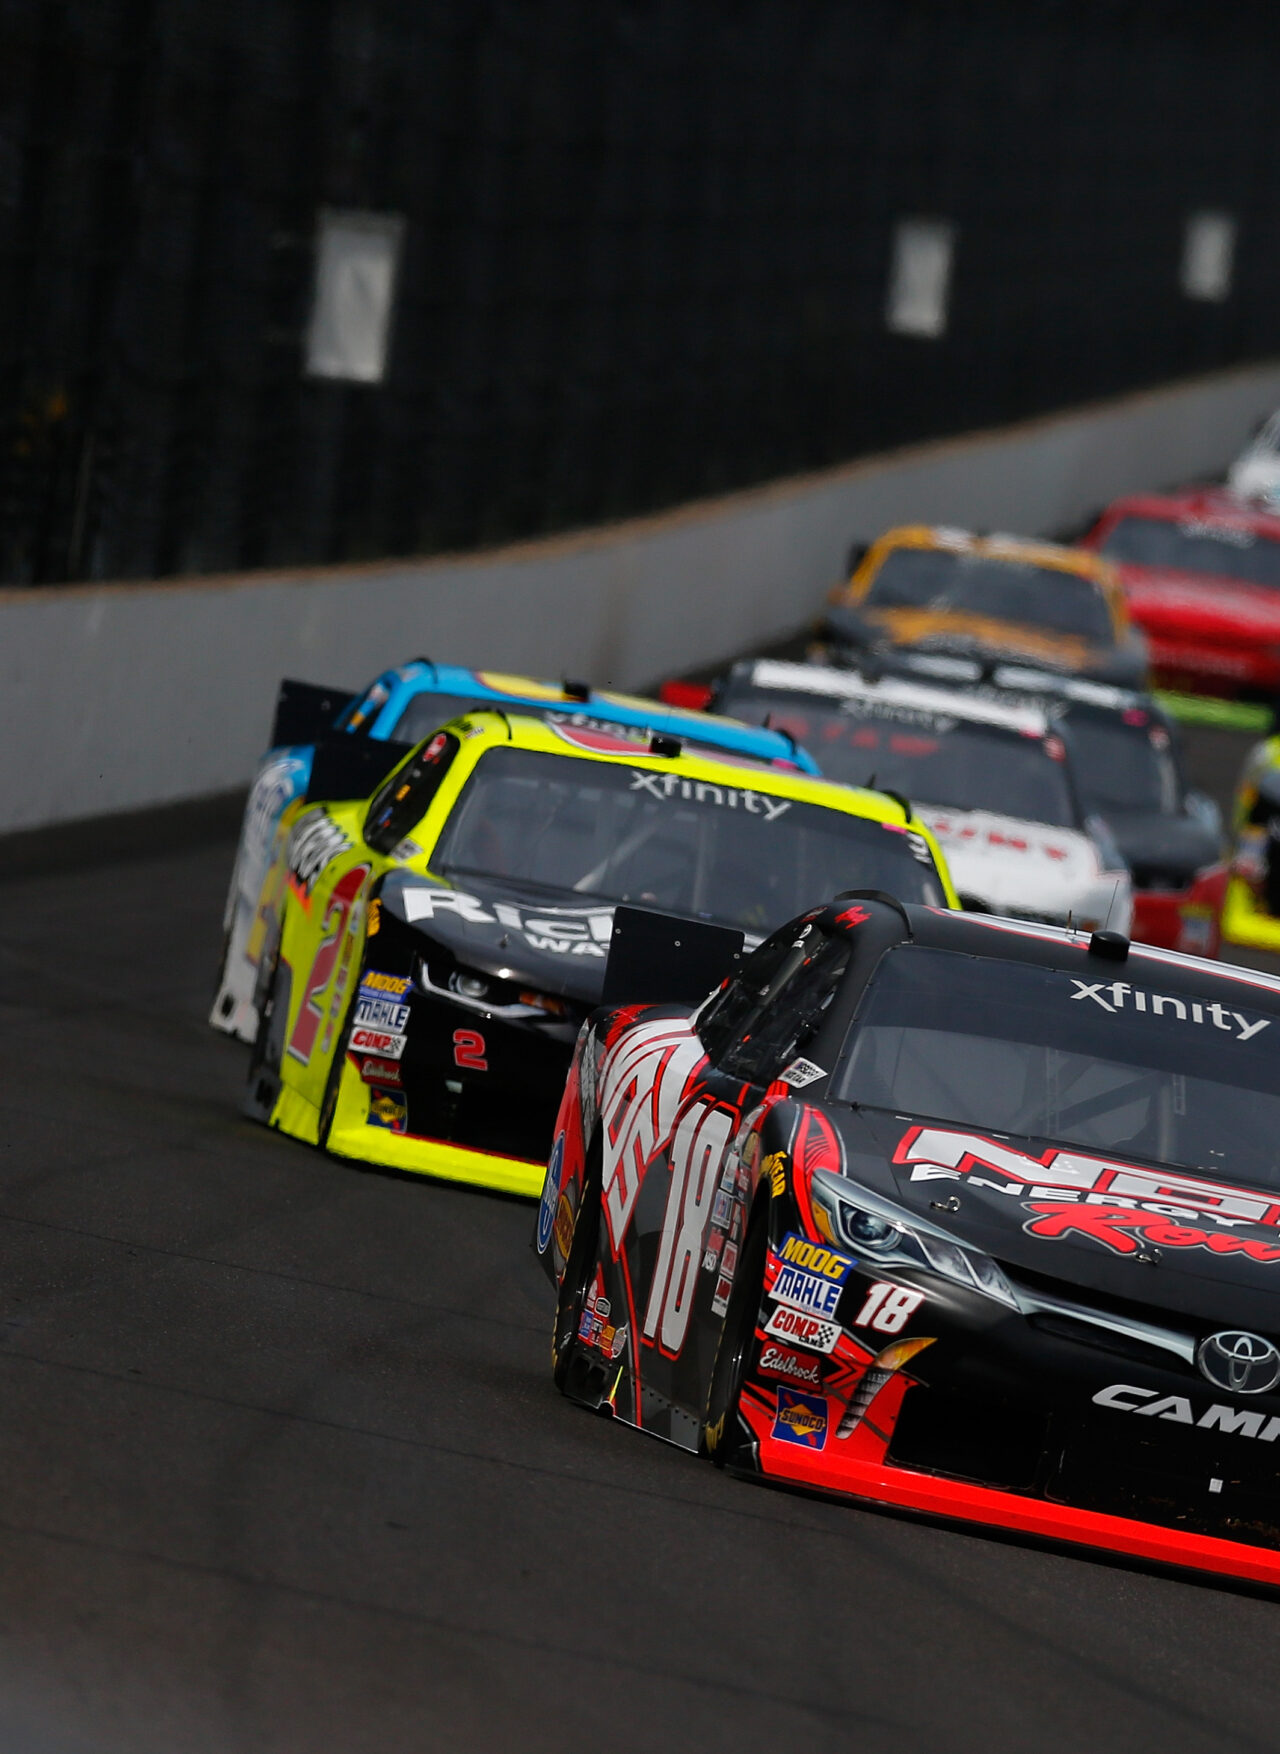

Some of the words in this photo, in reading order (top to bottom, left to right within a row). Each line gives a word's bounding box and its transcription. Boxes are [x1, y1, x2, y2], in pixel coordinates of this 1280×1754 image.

[362, 971, 414, 994] MOOG
[357, 1000, 408, 1029] MAHLE
[352, 1030, 392, 1050] COMP
[452, 1028, 488, 1071] 2
[910, 1164, 1255, 1227] ENERGY
[640, 1100, 738, 1356] 18
[779, 1237, 851, 1279] MOOG
[774, 1267, 840, 1313] MAHLE
[854, 1281, 925, 1334] 18
[772, 1310, 820, 1337] COMP
[760, 1348, 819, 1384] Edelbrock
[781, 1408, 826, 1432] SUNOCO
